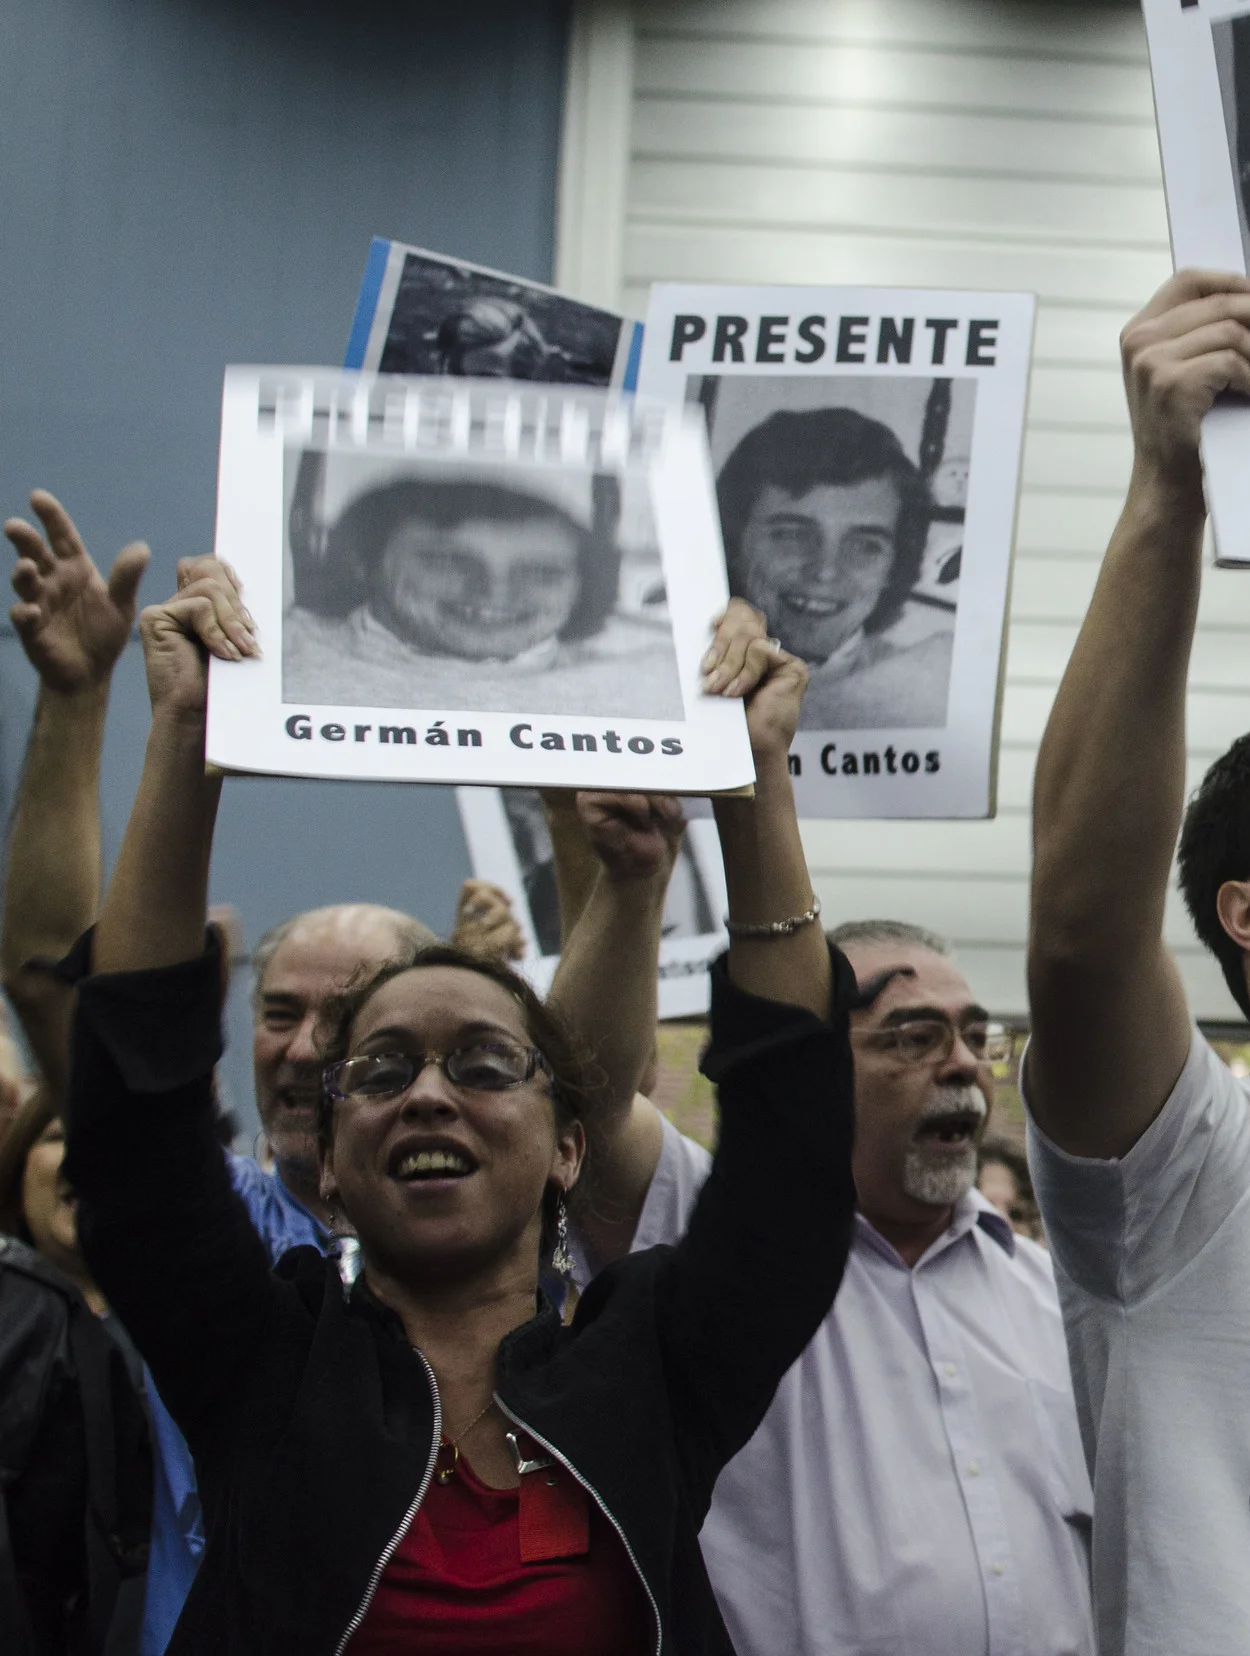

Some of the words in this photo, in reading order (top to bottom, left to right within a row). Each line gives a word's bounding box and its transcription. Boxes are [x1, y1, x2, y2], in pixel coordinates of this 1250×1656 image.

[669, 314, 999, 366] PRESENTE
[285, 713, 483, 747] Germán
[509, 722, 684, 756] Cantos
[820, 742, 941, 777] Cantos
